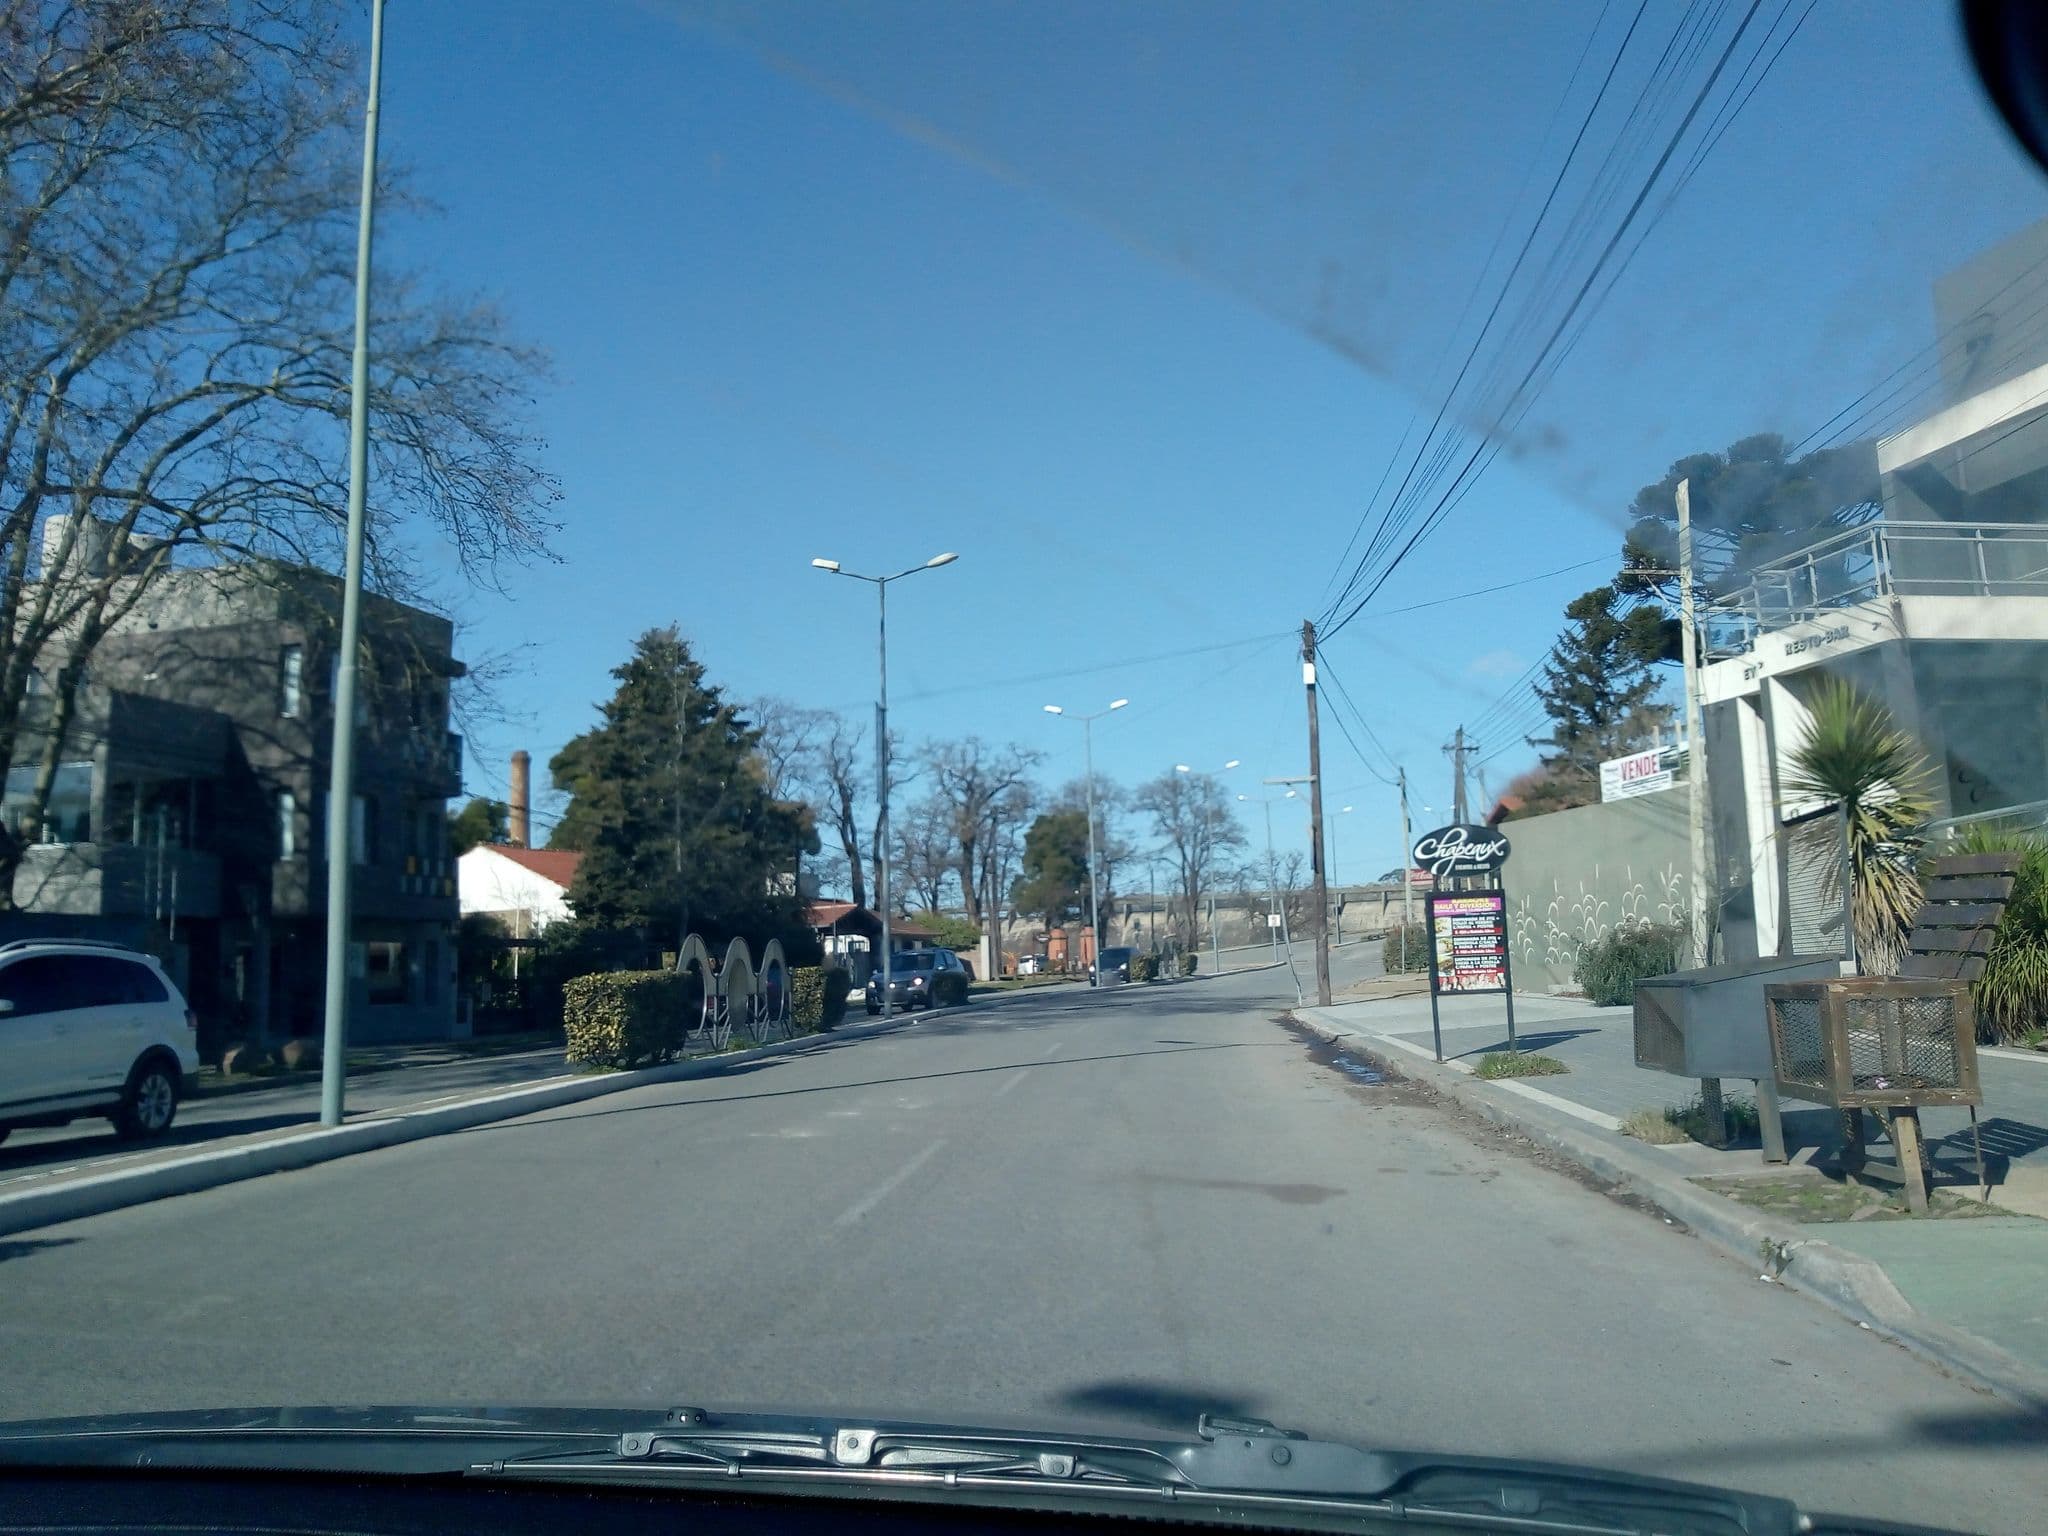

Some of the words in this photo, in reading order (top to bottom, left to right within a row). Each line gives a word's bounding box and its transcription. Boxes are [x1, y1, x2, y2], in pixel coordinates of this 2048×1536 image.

[1784, 625, 1849, 656] RESTO-BAR
[1621, 754, 1658, 781] VENDE
[1414, 827, 1507, 876] Chapeaux
